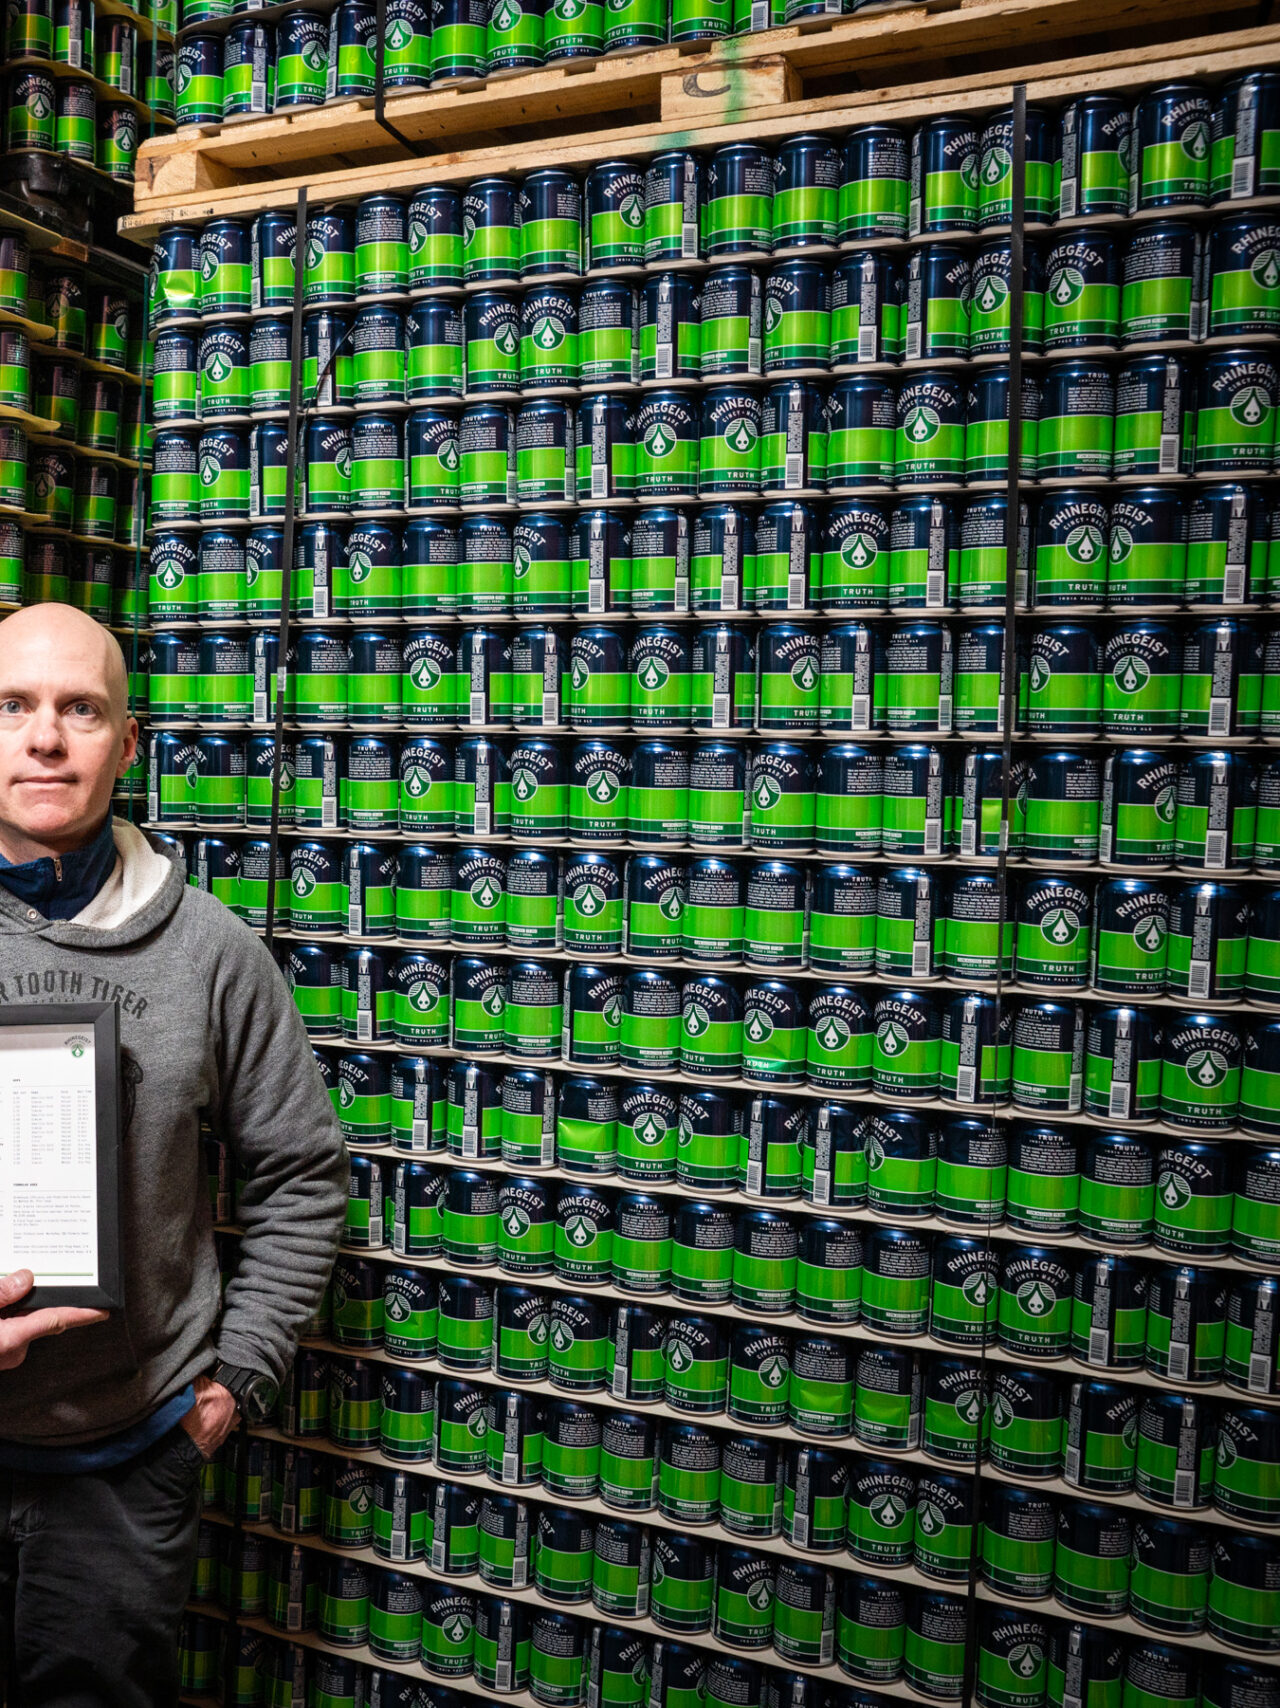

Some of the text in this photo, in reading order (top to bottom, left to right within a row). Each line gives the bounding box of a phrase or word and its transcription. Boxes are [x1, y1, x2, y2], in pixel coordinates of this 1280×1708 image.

[607, 26, 632, 37] TRUTH
[555, 37, 583, 46] TRUTH
[493, 49, 518, 57] TRUTH
[1049, 325, 1080, 335] TRUTH
[645, 476, 673, 484] TRUTH
[828, 512, 889, 537] RHINEGEIST
[639, 708, 665, 716] TRUTH
[565, 864, 619, 884] RHINEGEIST
[13, 970, 83, 997] TOOTH
[91, 976, 148, 1019] TIGER
[816, 1068, 846, 1077] TRUTH
[1187, 1106, 1222, 1115] TRUTH
[634, 1162, 663, 1170] TRUTH
[566, 1262, 593, 1271] TRUTH
[1005, 1260, 1069, 1282] RHINEGEIST
[1018, 1334, 1051, 1344] TRUTH
[871, 1544, 902, 1553] TRUTH
